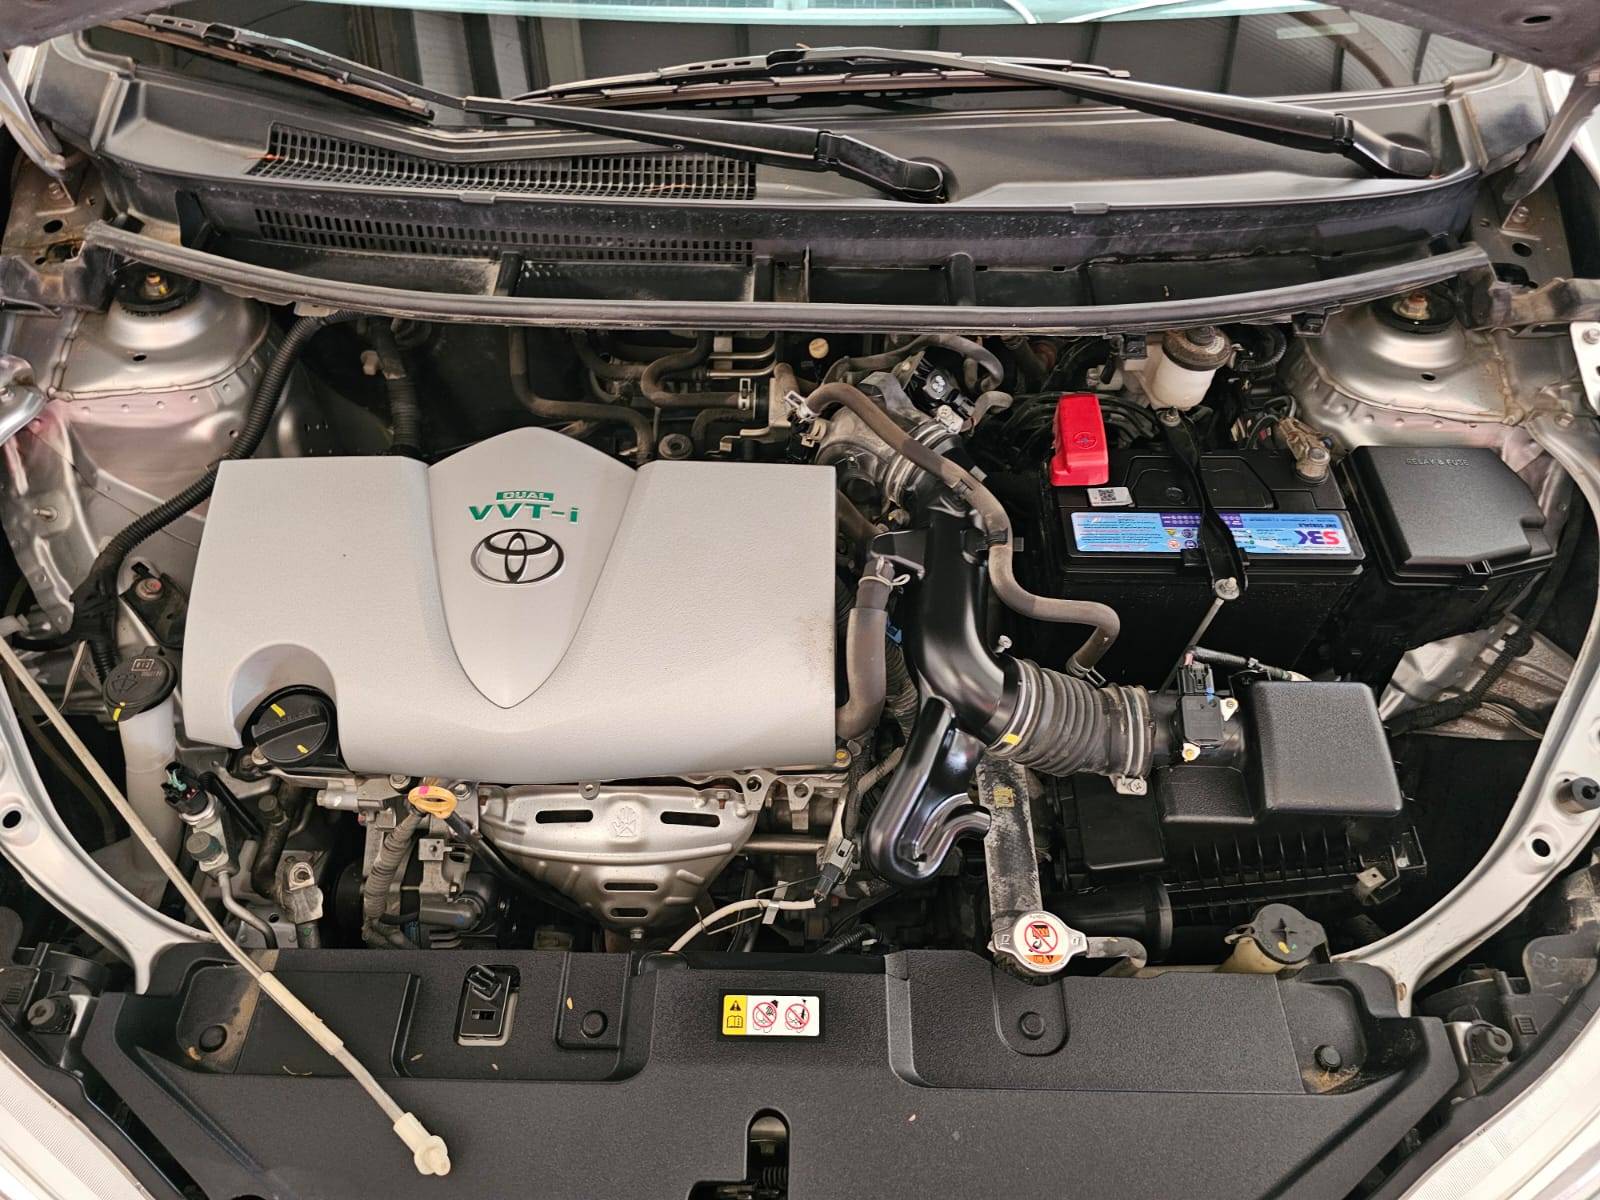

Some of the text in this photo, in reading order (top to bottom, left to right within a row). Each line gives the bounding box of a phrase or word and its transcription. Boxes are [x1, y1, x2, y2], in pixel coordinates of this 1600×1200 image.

[1405, 457, 1471, 466] RELAY & FUSE
[502, 491, 549, 500] DUAL
[468, 502, 579, 523] VVT-i
